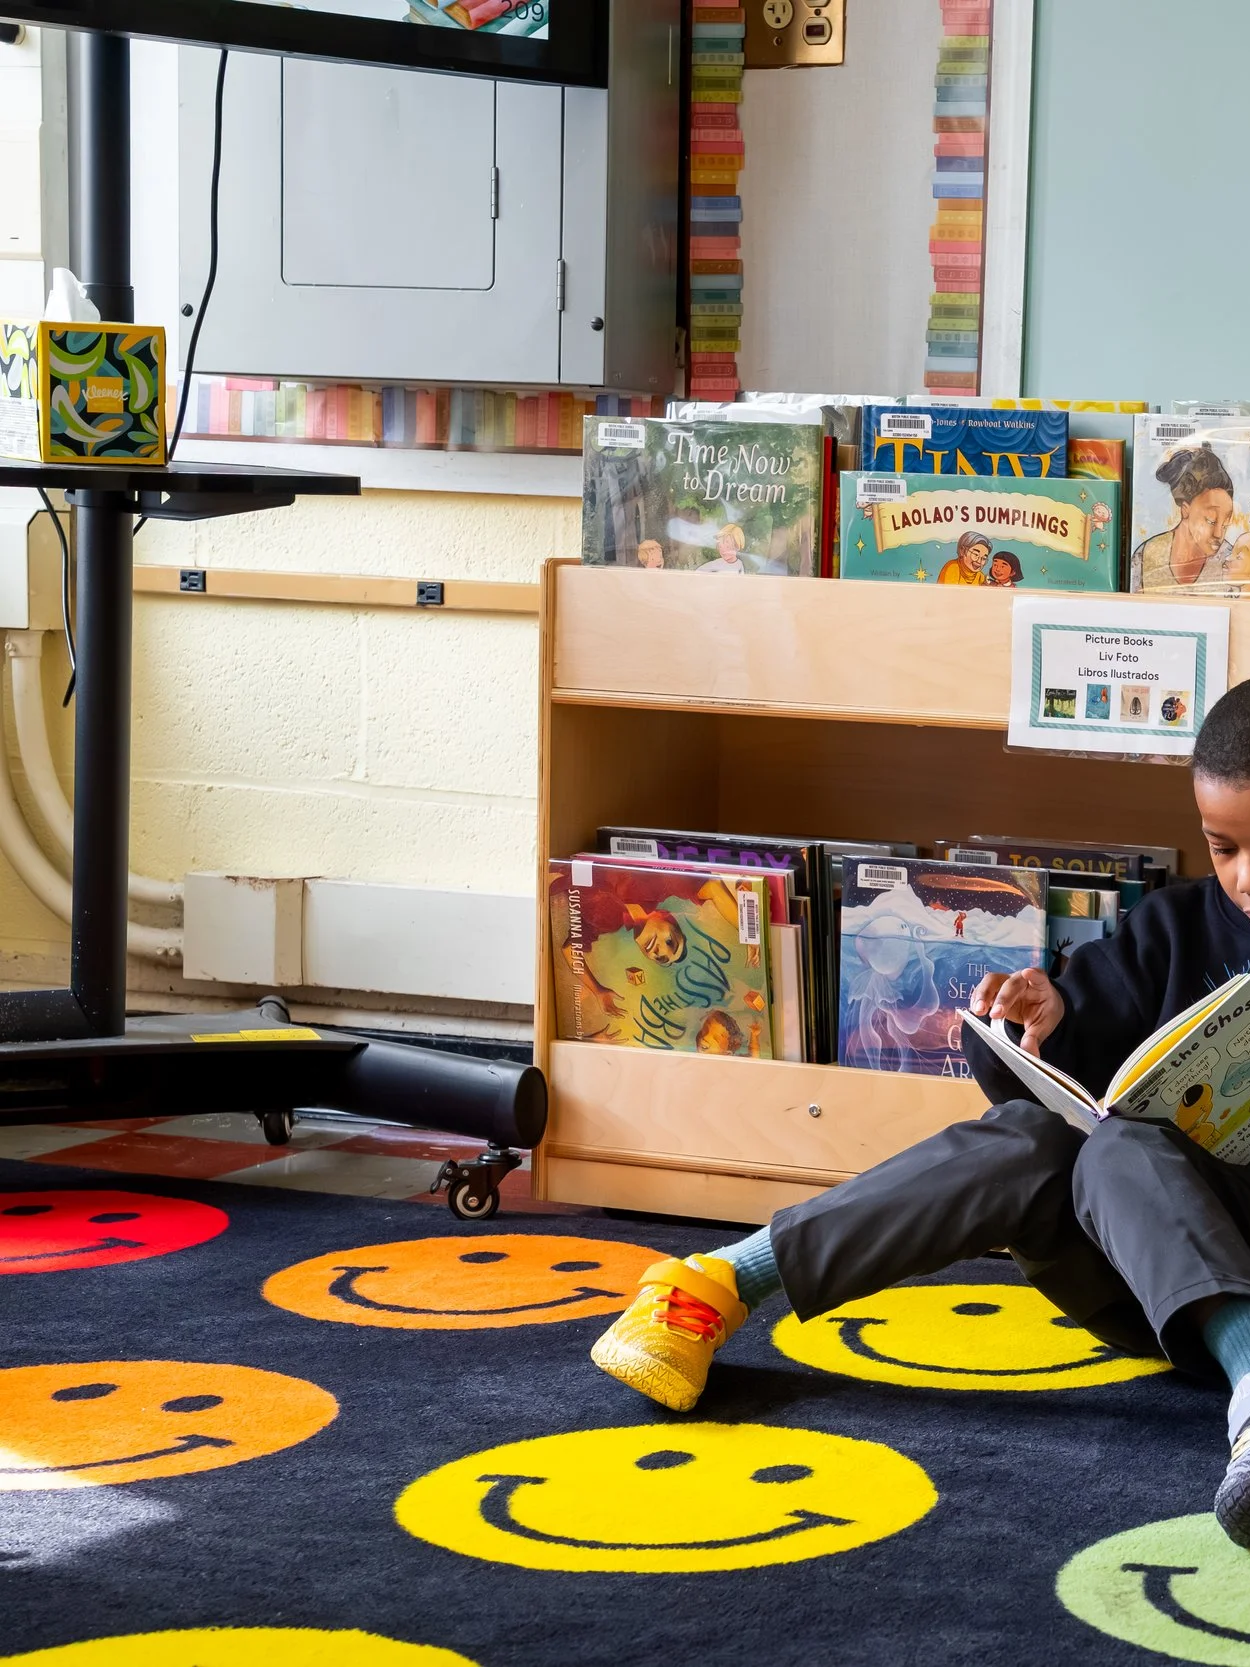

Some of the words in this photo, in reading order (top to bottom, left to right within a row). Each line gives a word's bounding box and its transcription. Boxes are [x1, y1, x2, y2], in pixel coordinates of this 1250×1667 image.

[501, 0, 544, 22] 209
[82, 385, 129, 402] Kleenex
[968, 419, 1001, 429] Rowboat
[1003, 420, 1035, 429] Watkins
[667, 430, 729, 465] Time
[732, 444, 791, 476] Now
[683, 472, 699, 490] to
[702, 469, 786, 503] Dream
[891, 505, 970, 531] LAOLAO'S
[975, 506, 1069, 538] DUMPLINGS
[891, 570, 901, 579] by
[1077, 579, 1086, 587] by
[1085, 634, 1121, 645] Picture
[1123, 636, 1154, 647] Books
[1099, 651, 1114, 662] Liv
[1116, 652, 1139, 663] Foto
[1078, 667, 1108, 678] Libros
[1110, 669, 1160, 682] Ilustrados
[567, 889, 584, 940] SUSANNA
[572, 942, 585, 975] REICH
[966, 962, 990, 977] THE
[574, 1031, 584, 1041] by
[1170, 1041, 1201, 1069] the
[1174, 1068, 1195, 1088] don't
[1195, 1055, 1209, 1068] see
[1175, 1061, 1211, 1095] anything!
[1215, 1139, 1234, 1157] hree
